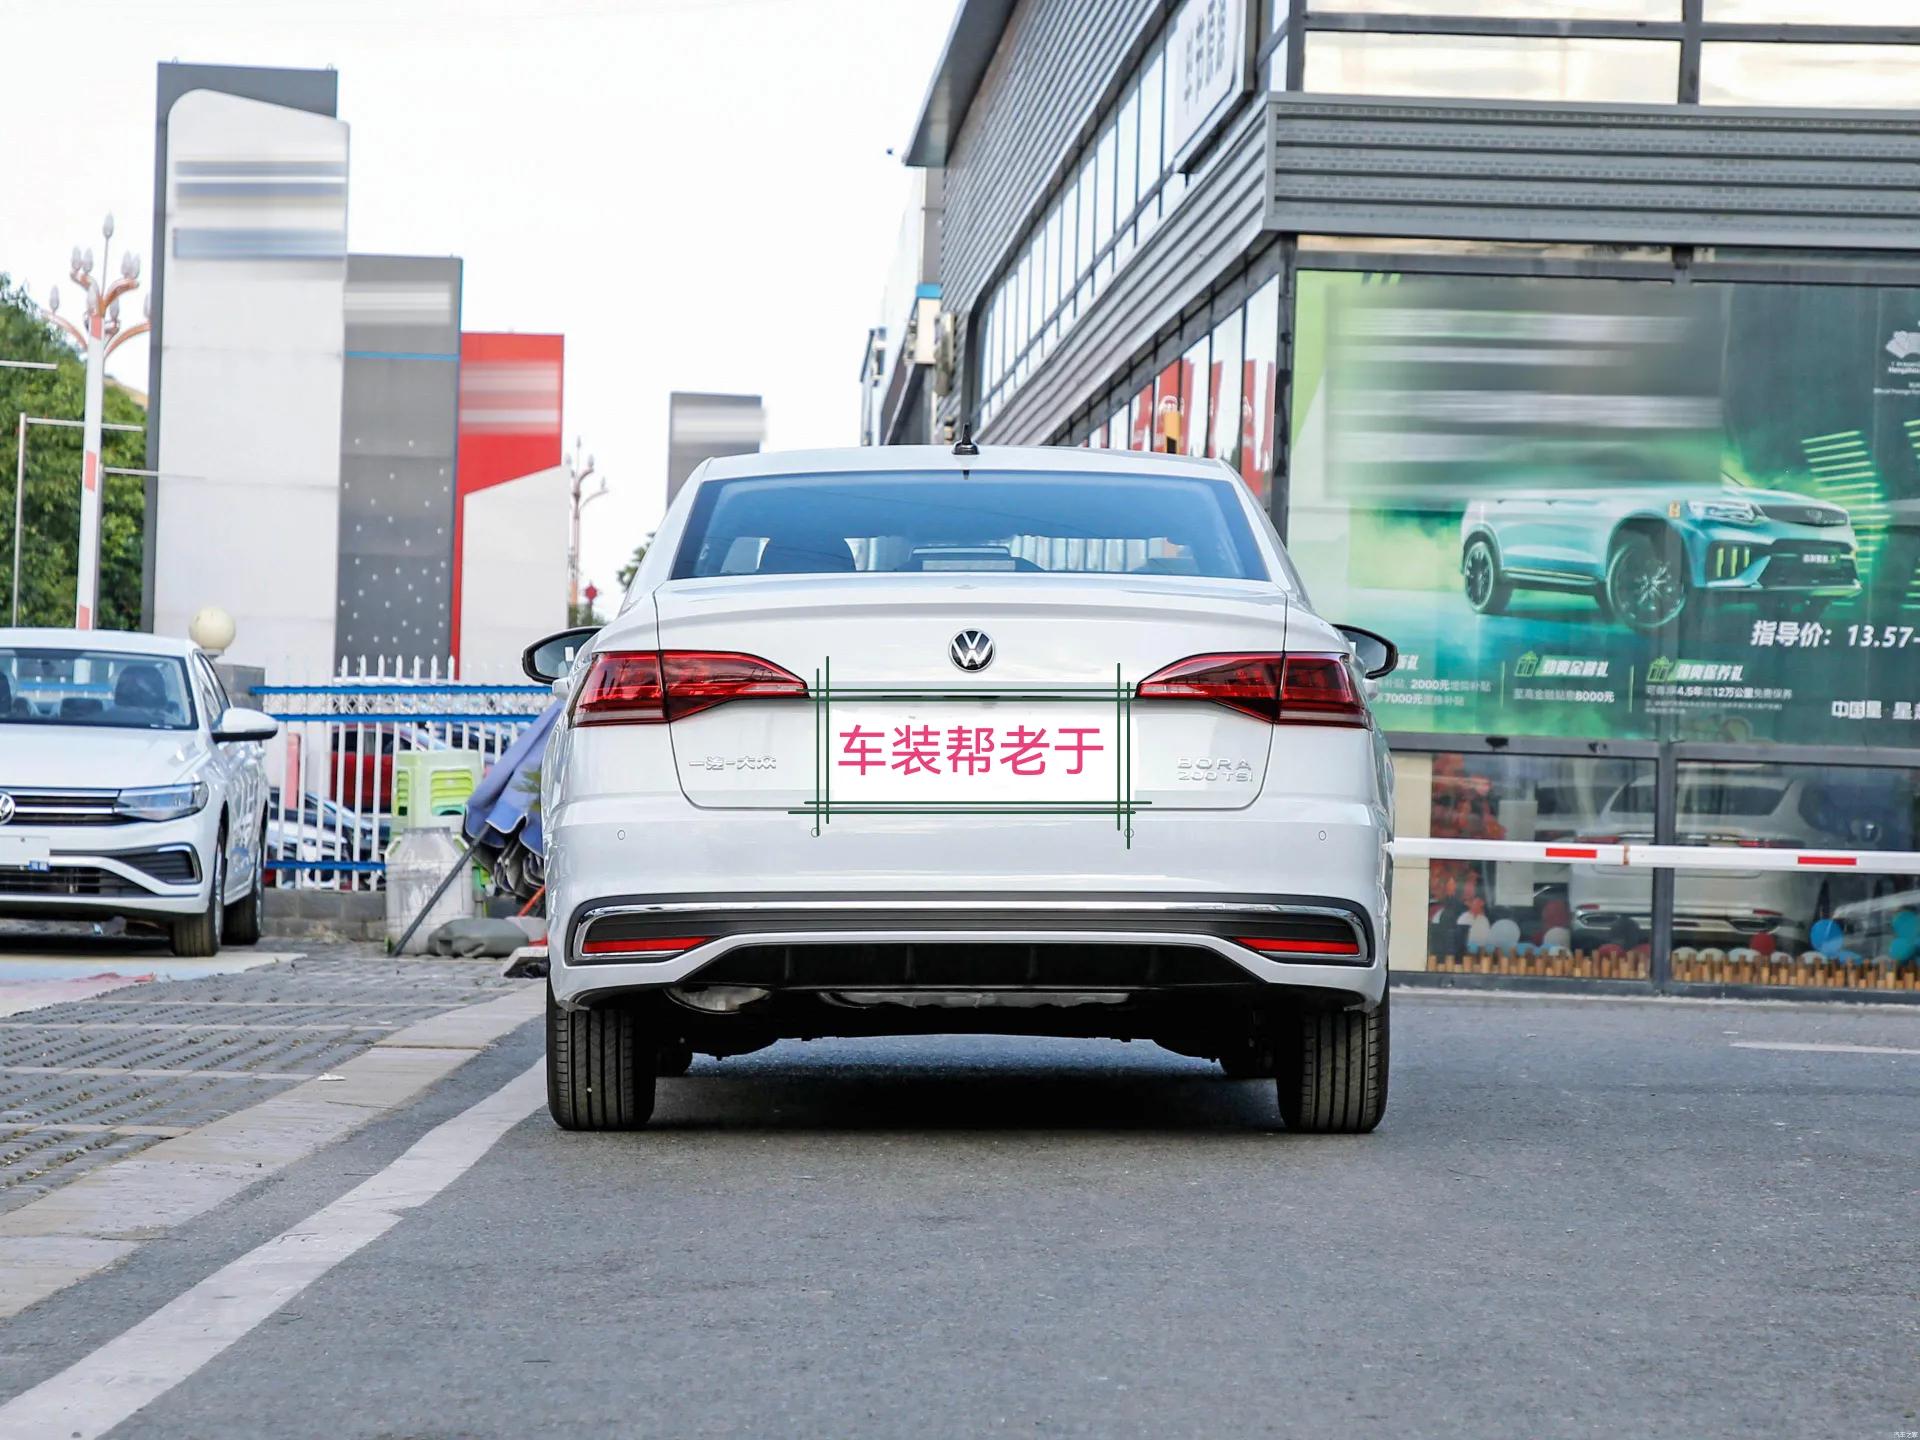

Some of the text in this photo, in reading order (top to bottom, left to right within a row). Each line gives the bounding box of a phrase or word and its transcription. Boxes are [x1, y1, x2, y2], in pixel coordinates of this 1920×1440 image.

[1177, 756, 1252, 771] BORA
[1177, 770, 1253, 783] 200 TSI
